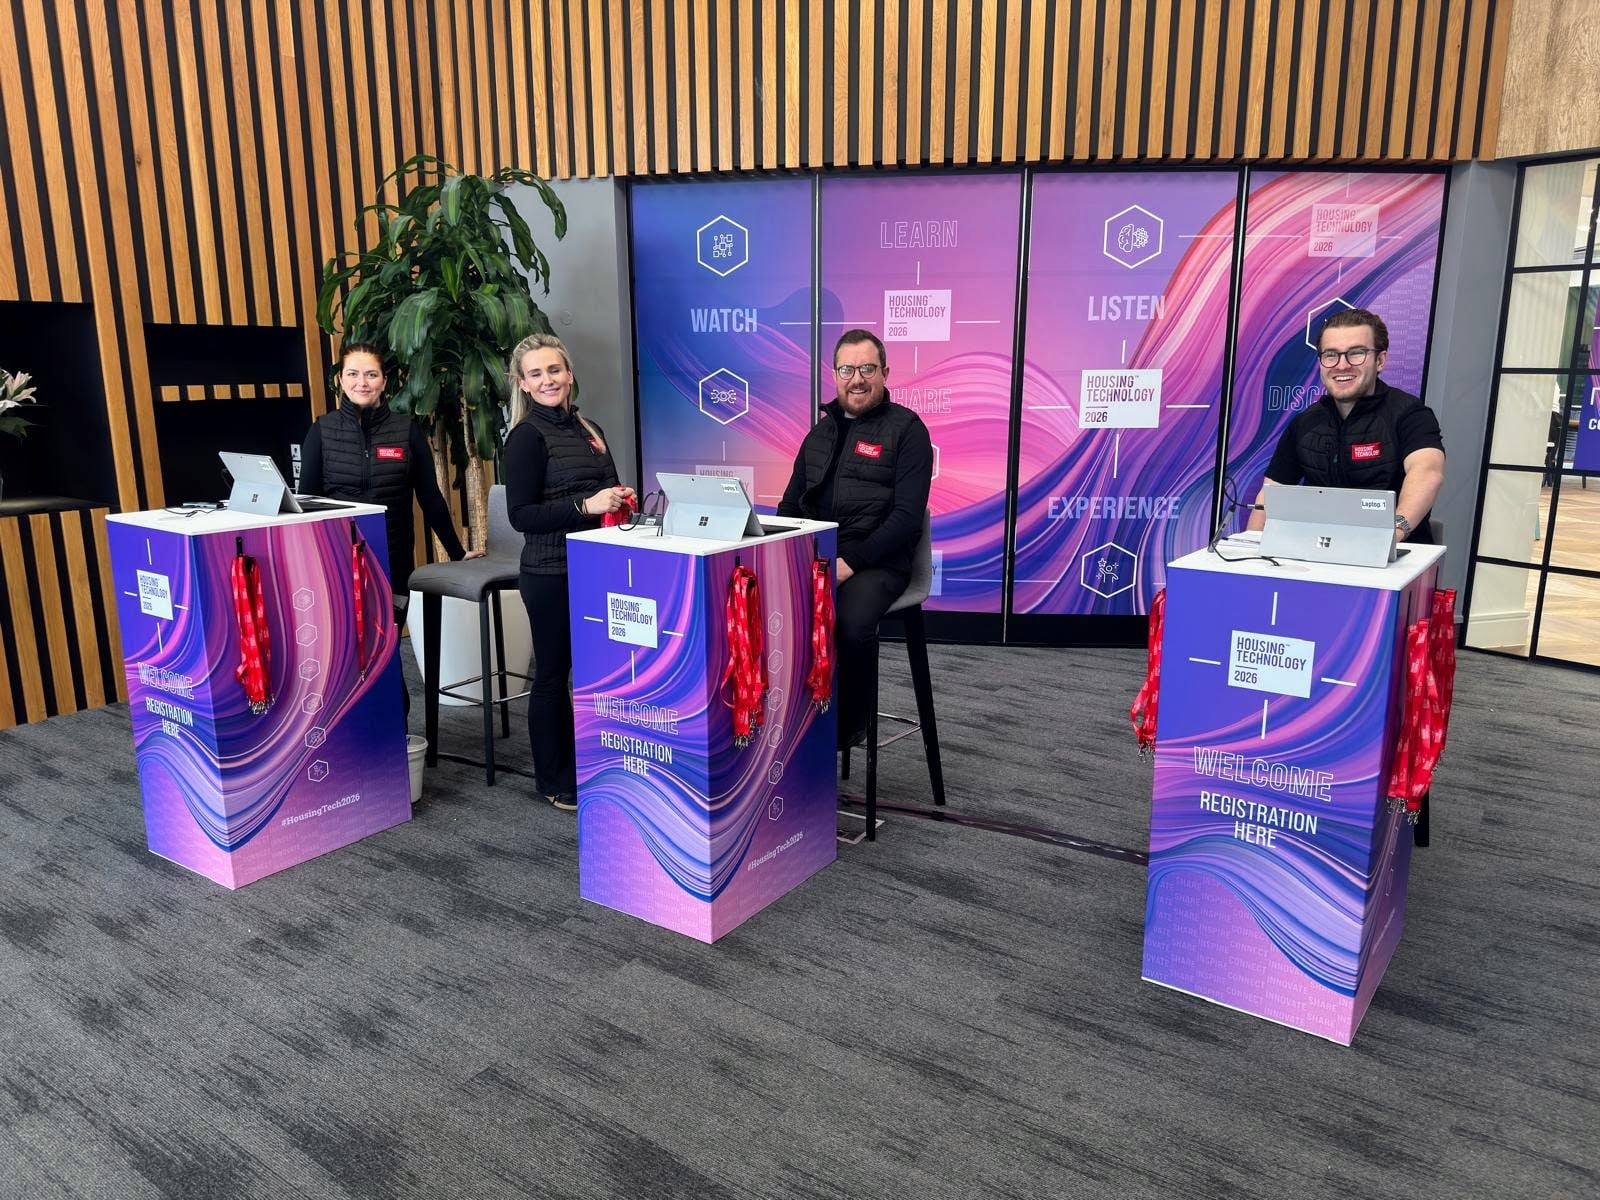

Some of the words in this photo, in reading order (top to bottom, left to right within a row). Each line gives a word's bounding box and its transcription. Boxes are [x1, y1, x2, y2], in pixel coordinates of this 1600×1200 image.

[880, 220, 959, 249] LEARN
[1316, 220, 1373, 233] TECHNOLOGY
[1313, 241, 1334, 252] 2026
[889, 295, 928, 307] HOUSING
[889, 306, 946, 318] TECHNOLOGY
[1087, 295, 1166, 321] LISTEN
[691, 308, 758, 333] WATCH
[888, 326, 908, 337] 2026
[1087, 375, 1135, 389] HOUSING
[889, 388, 952, 414] HARE
[1086, 388, 1155, 402] TECHNOLOGY
[1268, 385, 1328, 411] DISC
[1085, 411, 1108, 423] 2026
[1047, 496, 1181, 519] EXPERIENCE
[610, 597, 640, 613] HOUSING
[611, 608, 653, 625] TECHNOLOGY
[611, 626, 626, 637] 2026
[1237, 636, 1285, 655] HOUSING
[1236, 649, 1307, 671] TECHNOLOGY
[137, 661, 194, 700] WELCOME
[1234, 670, 1258, 684] 2026
[145, 696, 193, 727] REGISTRATION
[593, 692, 679, 735] WELCOME
[162, 718, 181, 739] HERE
[600, 730, 673, 764] REGISTRATION
[623, 754, 650, 777] HERE
[1193, 746, 1334, 802] WELCOME
[281, 793, 361, 827] #HousingTech2026
[1200, 790, 1318, 835] REGISTRATION
[1234, 820, 1278, 848] HERE
